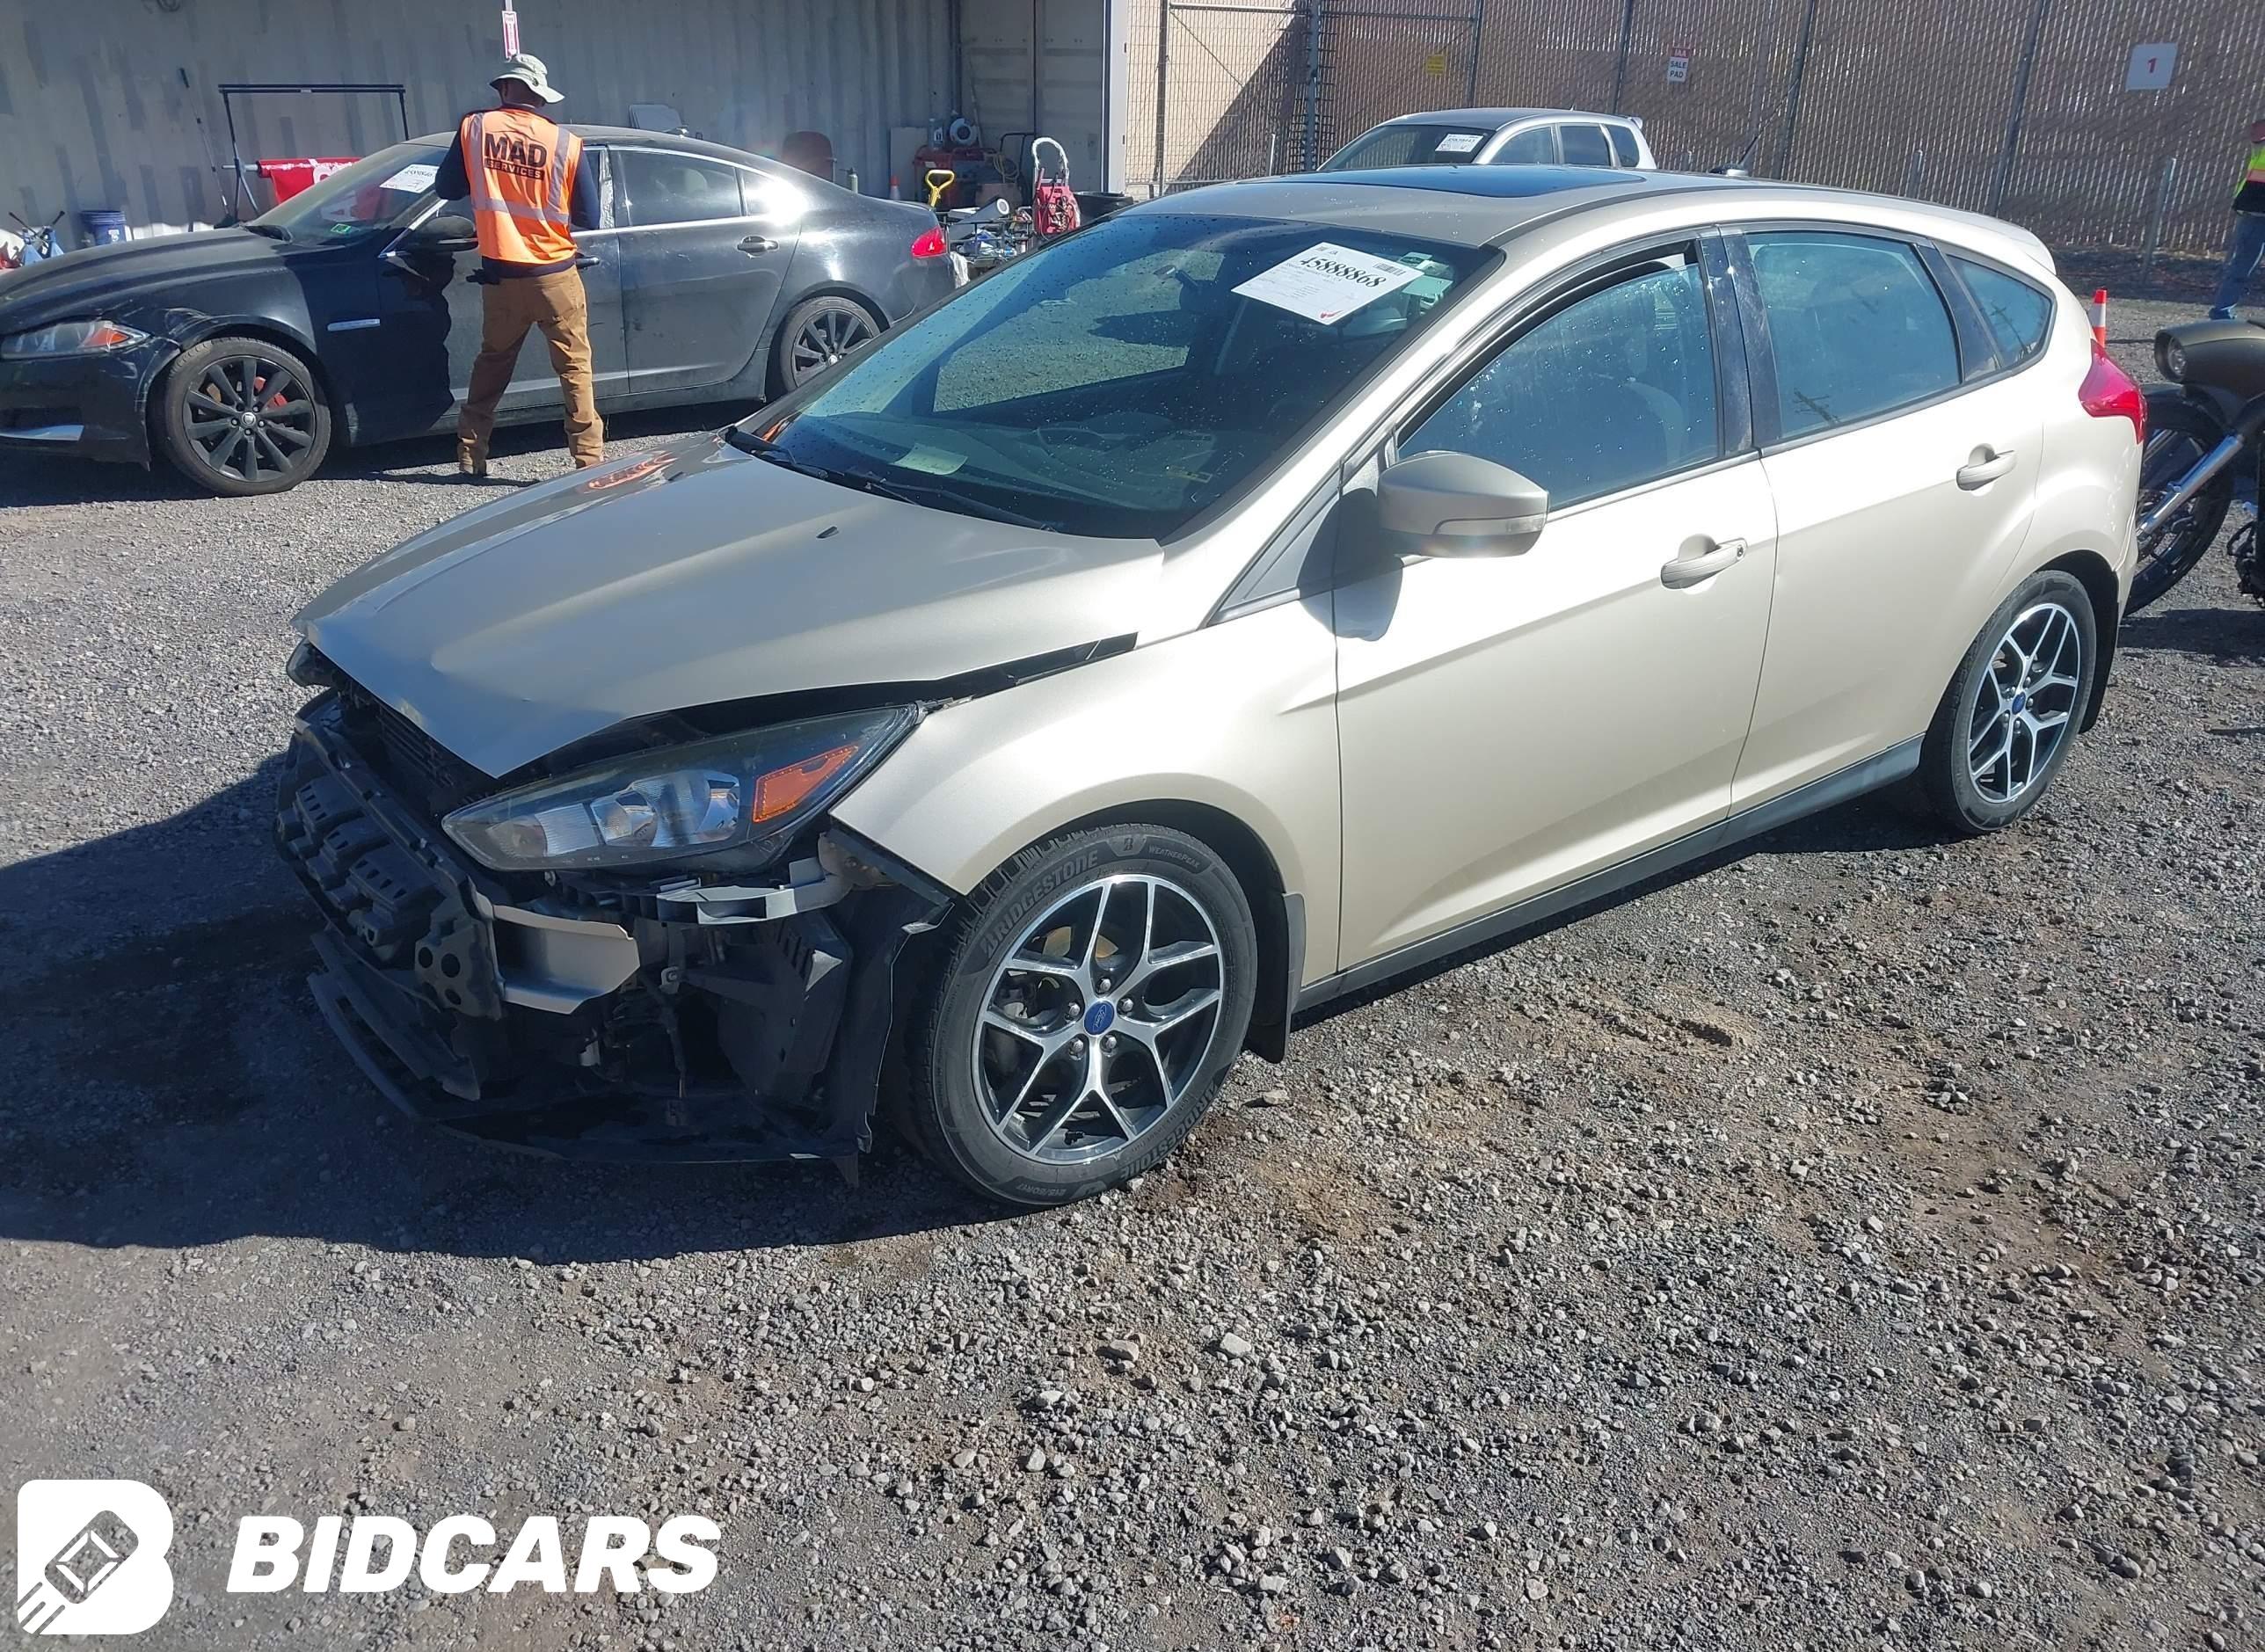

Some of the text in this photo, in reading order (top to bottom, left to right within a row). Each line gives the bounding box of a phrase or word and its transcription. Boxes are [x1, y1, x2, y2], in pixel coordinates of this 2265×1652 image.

[2148, 57, 2157, 73] 1
[484, 133, 547, 168] MAD
[488, 159, 542, 178] SERVICES
[1300, 257, 1387, 287] 45888868
[980, 849, 1098, 954] BRIDGESTONE
